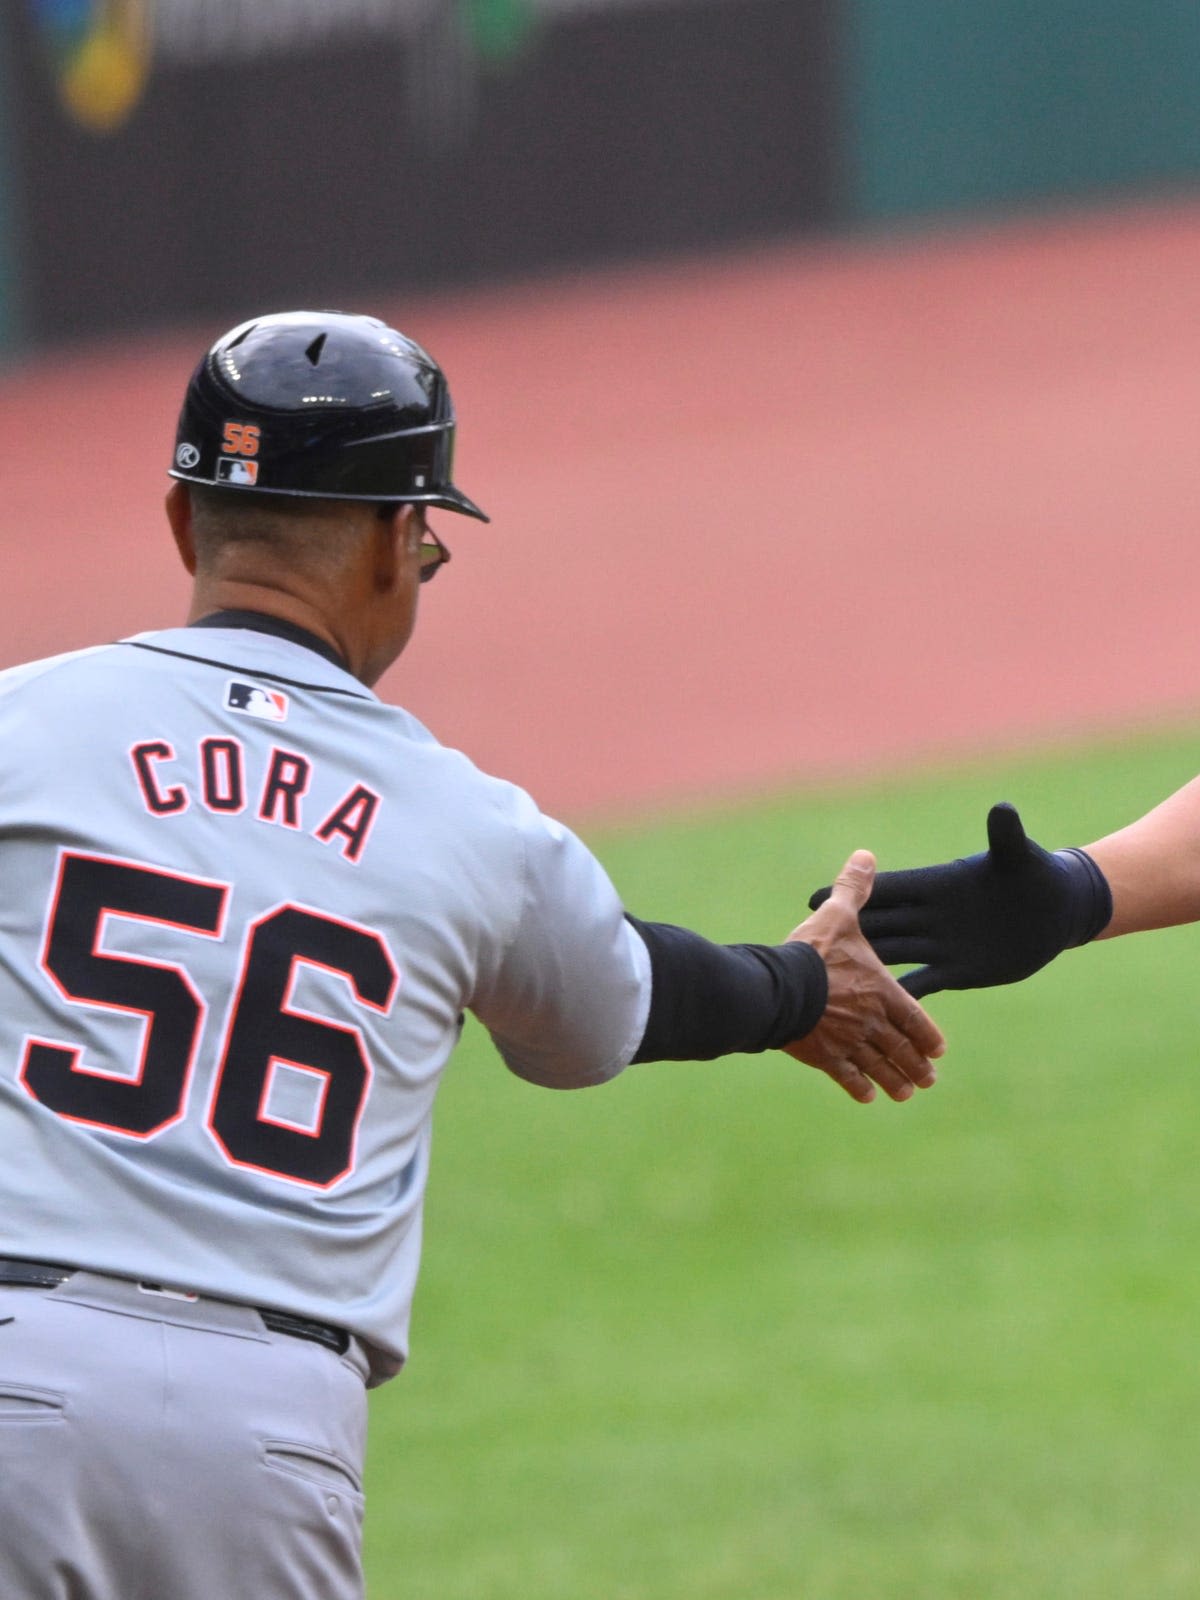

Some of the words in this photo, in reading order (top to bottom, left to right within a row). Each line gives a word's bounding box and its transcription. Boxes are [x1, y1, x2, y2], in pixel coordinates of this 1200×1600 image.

[222, 422, 261, 456] 56
[131, 737, 380, 864] CORA
[19, 847, 399, 1190] 56
